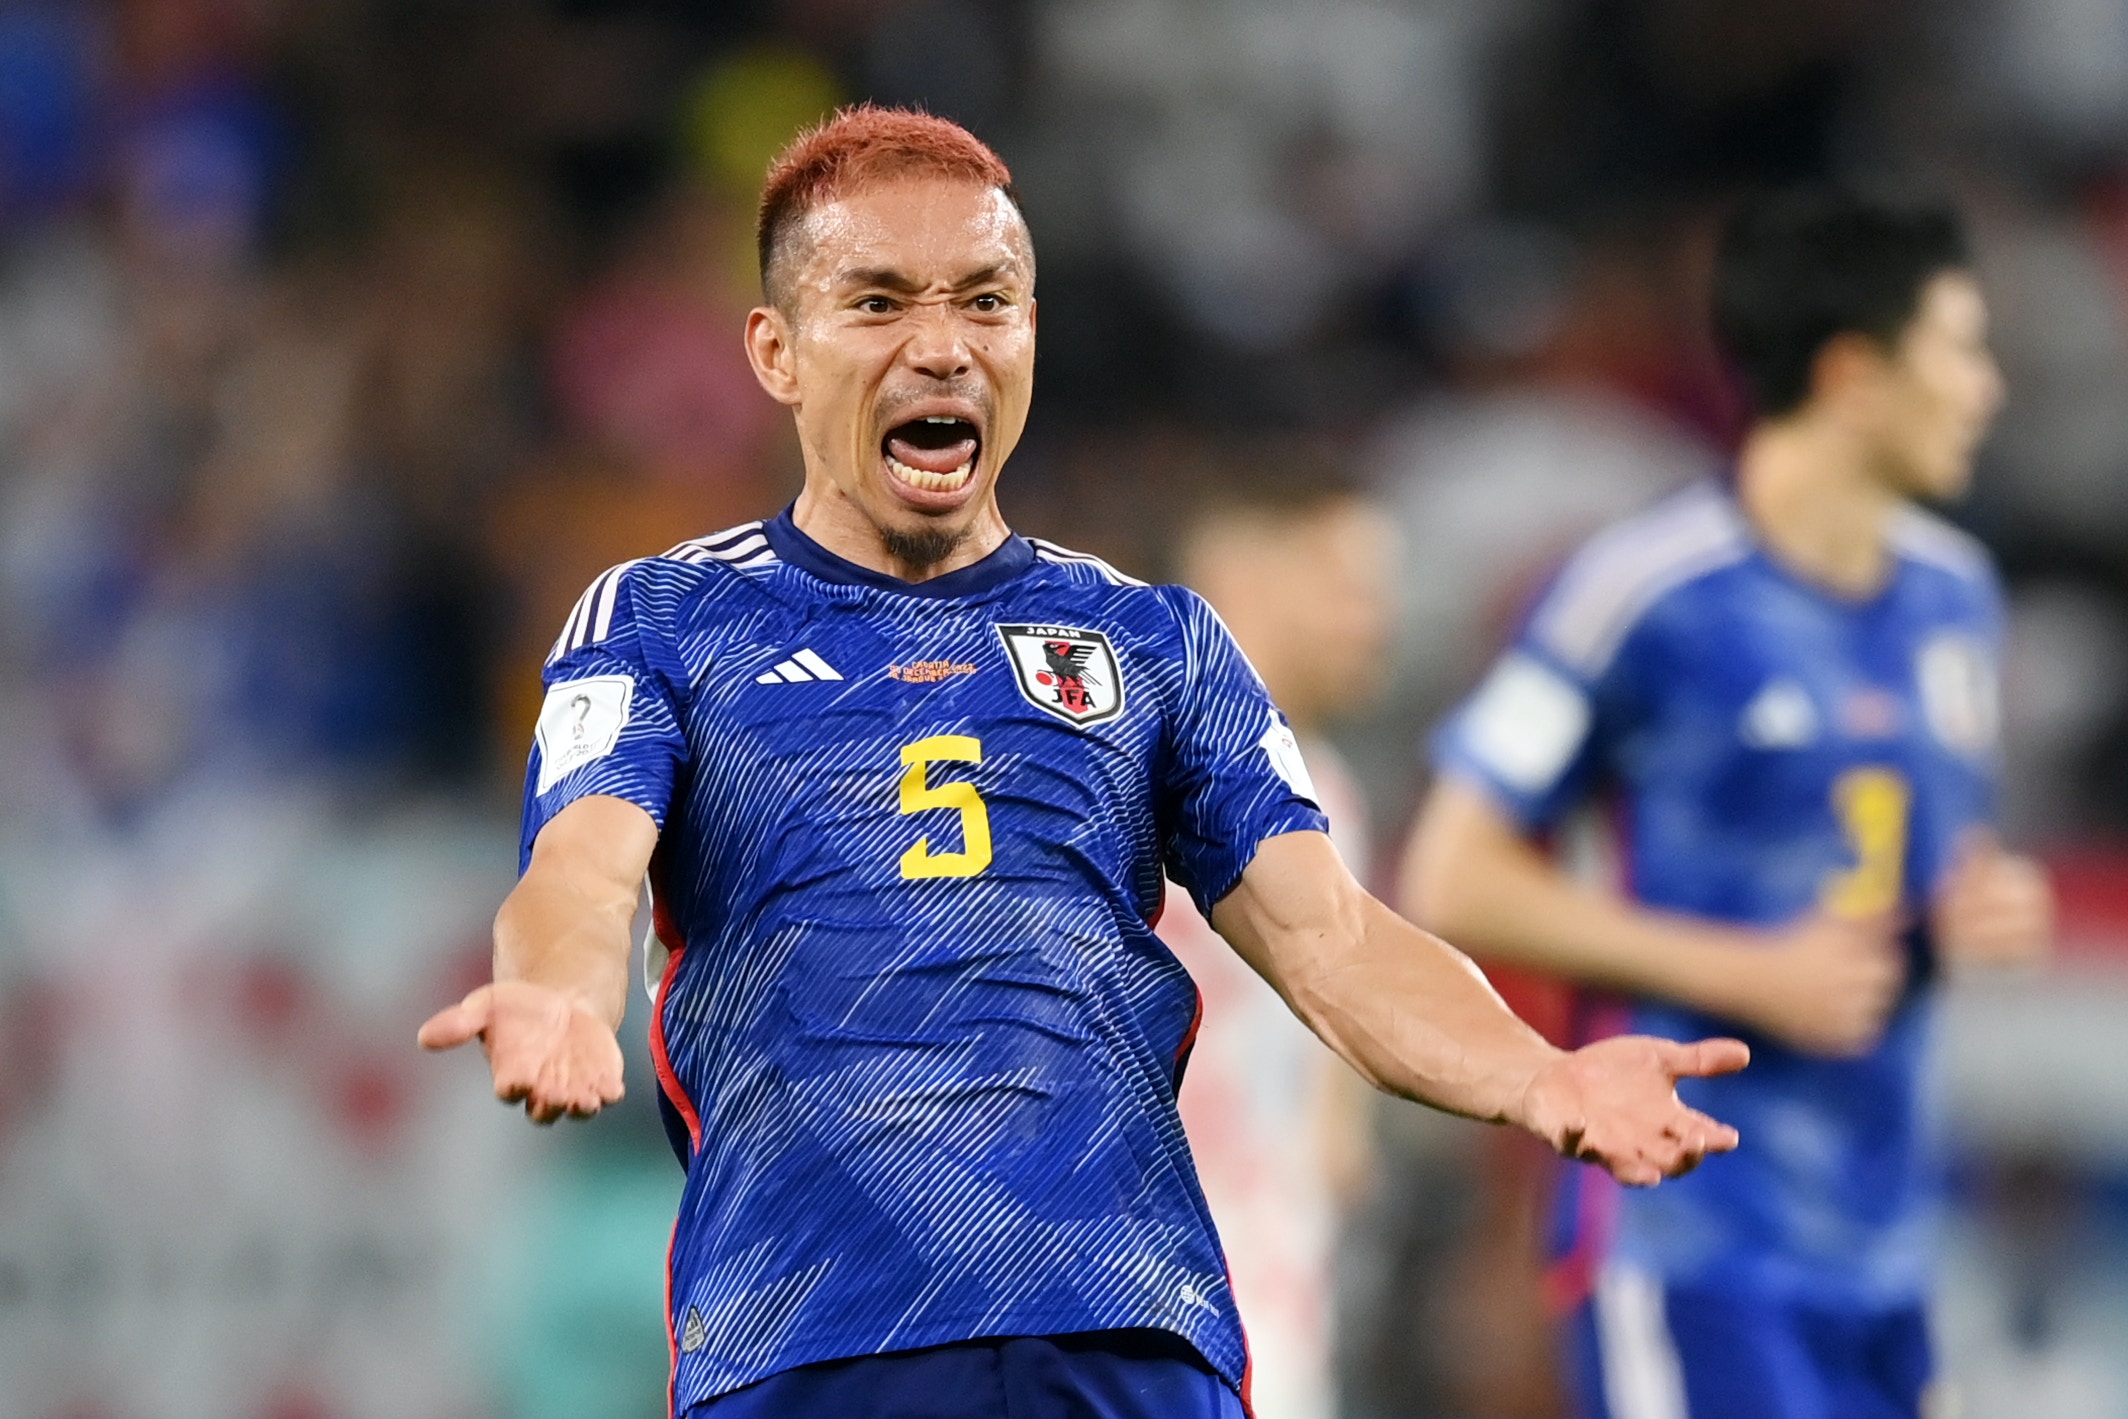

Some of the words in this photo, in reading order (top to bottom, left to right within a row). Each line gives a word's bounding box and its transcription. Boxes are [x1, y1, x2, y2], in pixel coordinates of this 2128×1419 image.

[1026, 627, 1081, 638] JAPAN
[1051, 688, 1097, 708] JFA
[900, 735, 993, 880] 5
